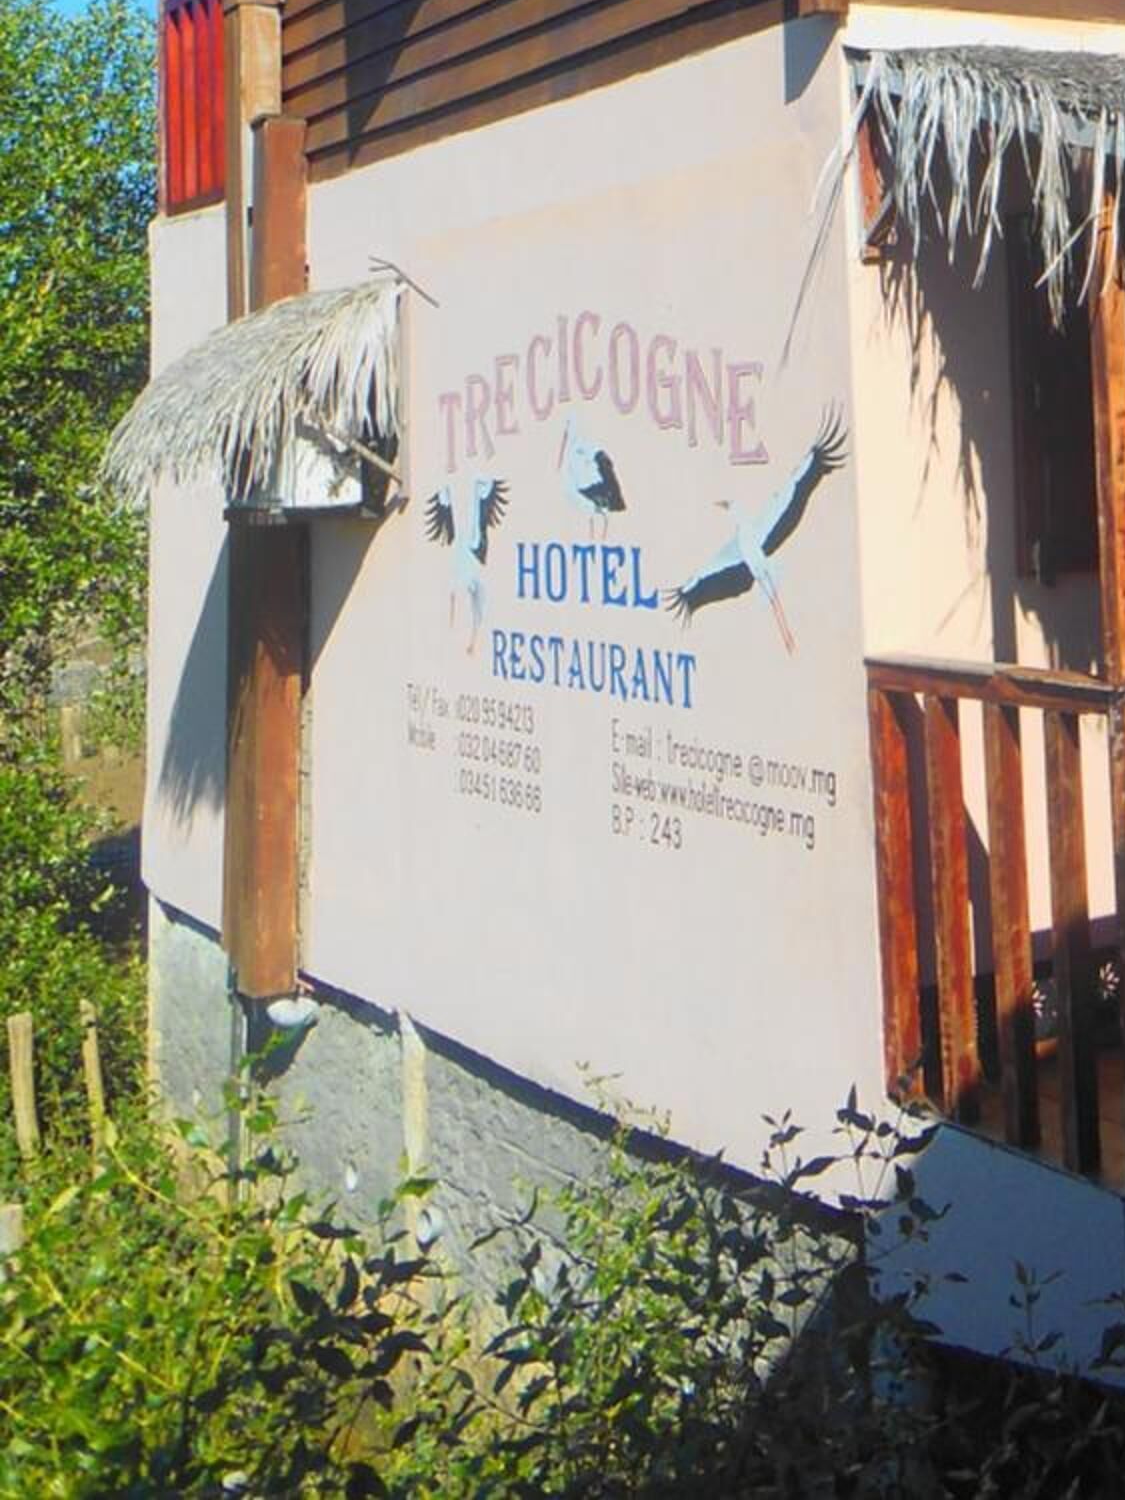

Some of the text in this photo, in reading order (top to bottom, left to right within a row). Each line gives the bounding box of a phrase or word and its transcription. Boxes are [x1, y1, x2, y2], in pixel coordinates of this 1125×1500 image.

[438, 310, 769, 474] TRECICOGNE
[516, 542, 659, 609] HOTEL
[492, 629, 697, 709] RESTAURANT
[650, 811, 683, 850] 243
